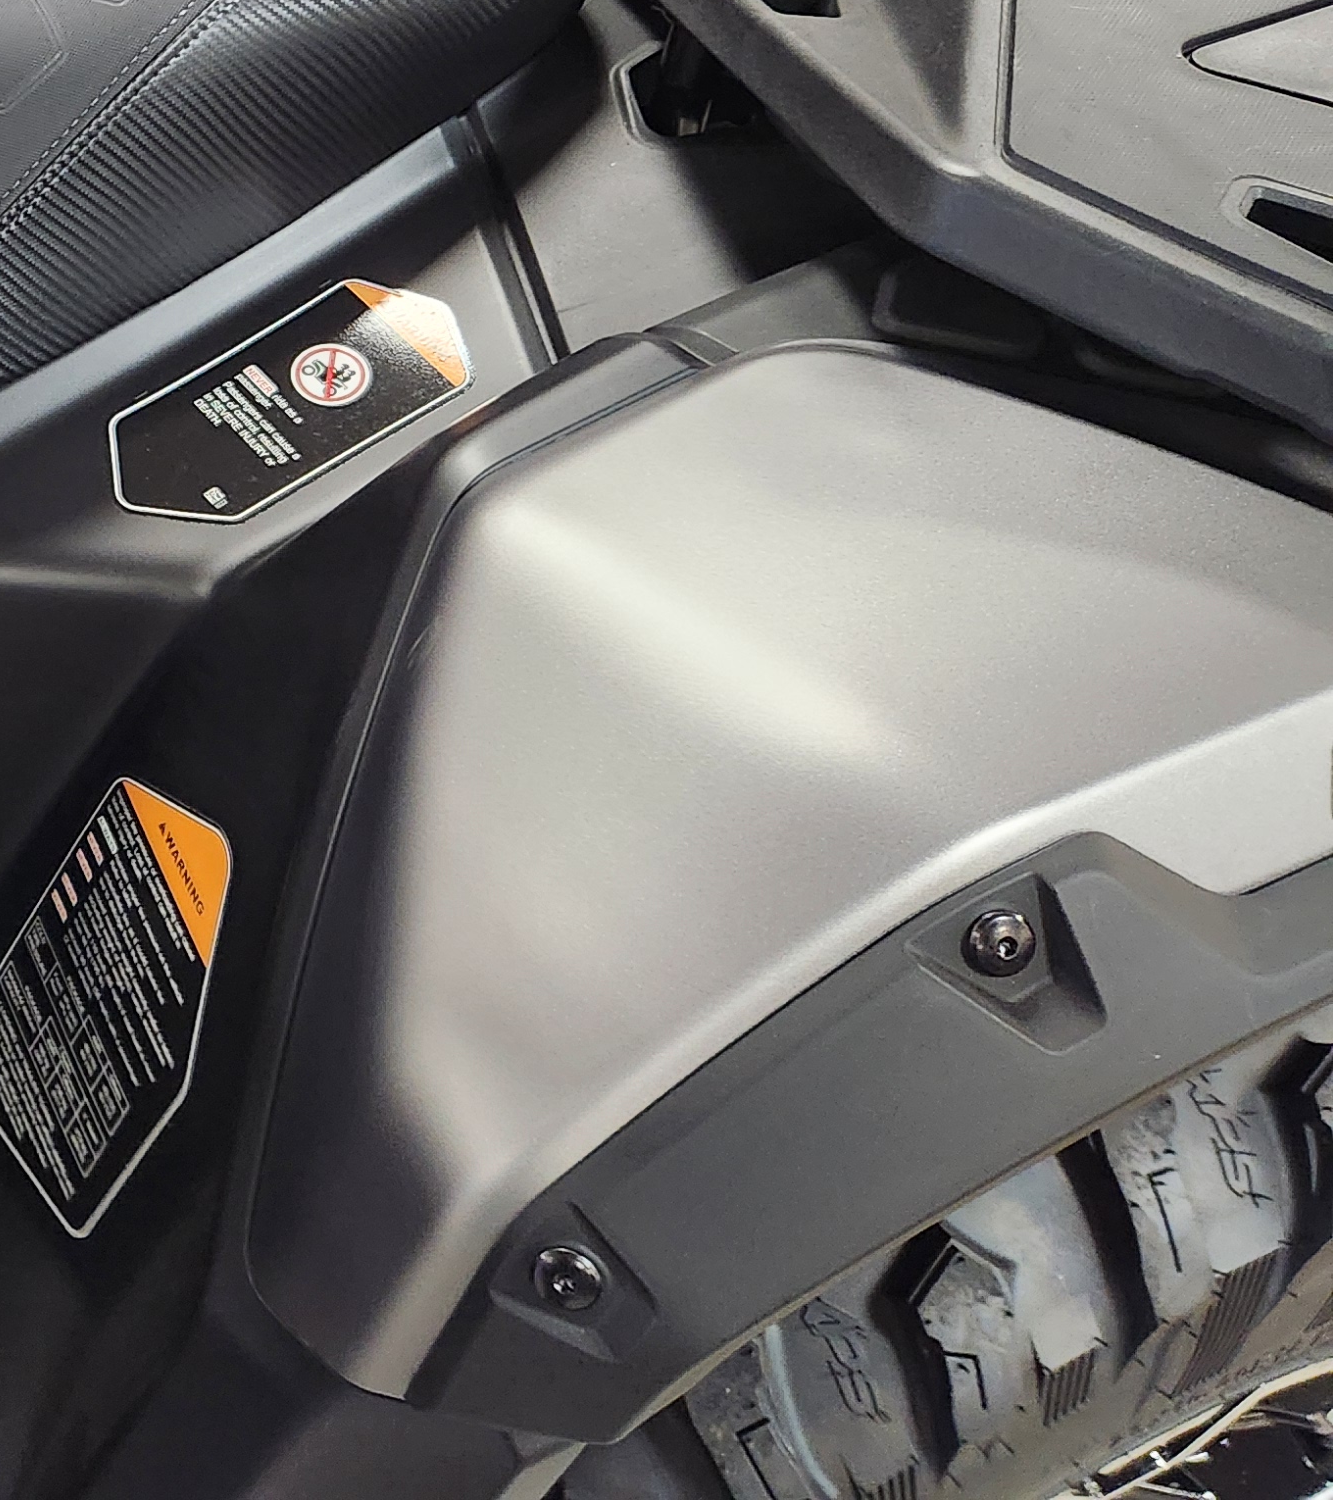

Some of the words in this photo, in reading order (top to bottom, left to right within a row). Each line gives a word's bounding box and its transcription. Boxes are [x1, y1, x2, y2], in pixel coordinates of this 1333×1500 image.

[194, 398, 221, 426] DEATH.
[213, 386, 229, 402] loss
[253, 433, 288, 463] resulting
[222, 381, 262, 420] Passengers
[259, 419, 275, 433] can
[272, 432, 295, 453] cause
[246, 368, 271, 394] NEVER
[271, 394, 287, 408] ride
[284, 408, 296, 417] as
[210, 400, 242, 431] SEVERE
[238, 429, 269, 456] INJURY
[264, 457, 275, 465] or
[165, 831, 205, 916] WARNING
